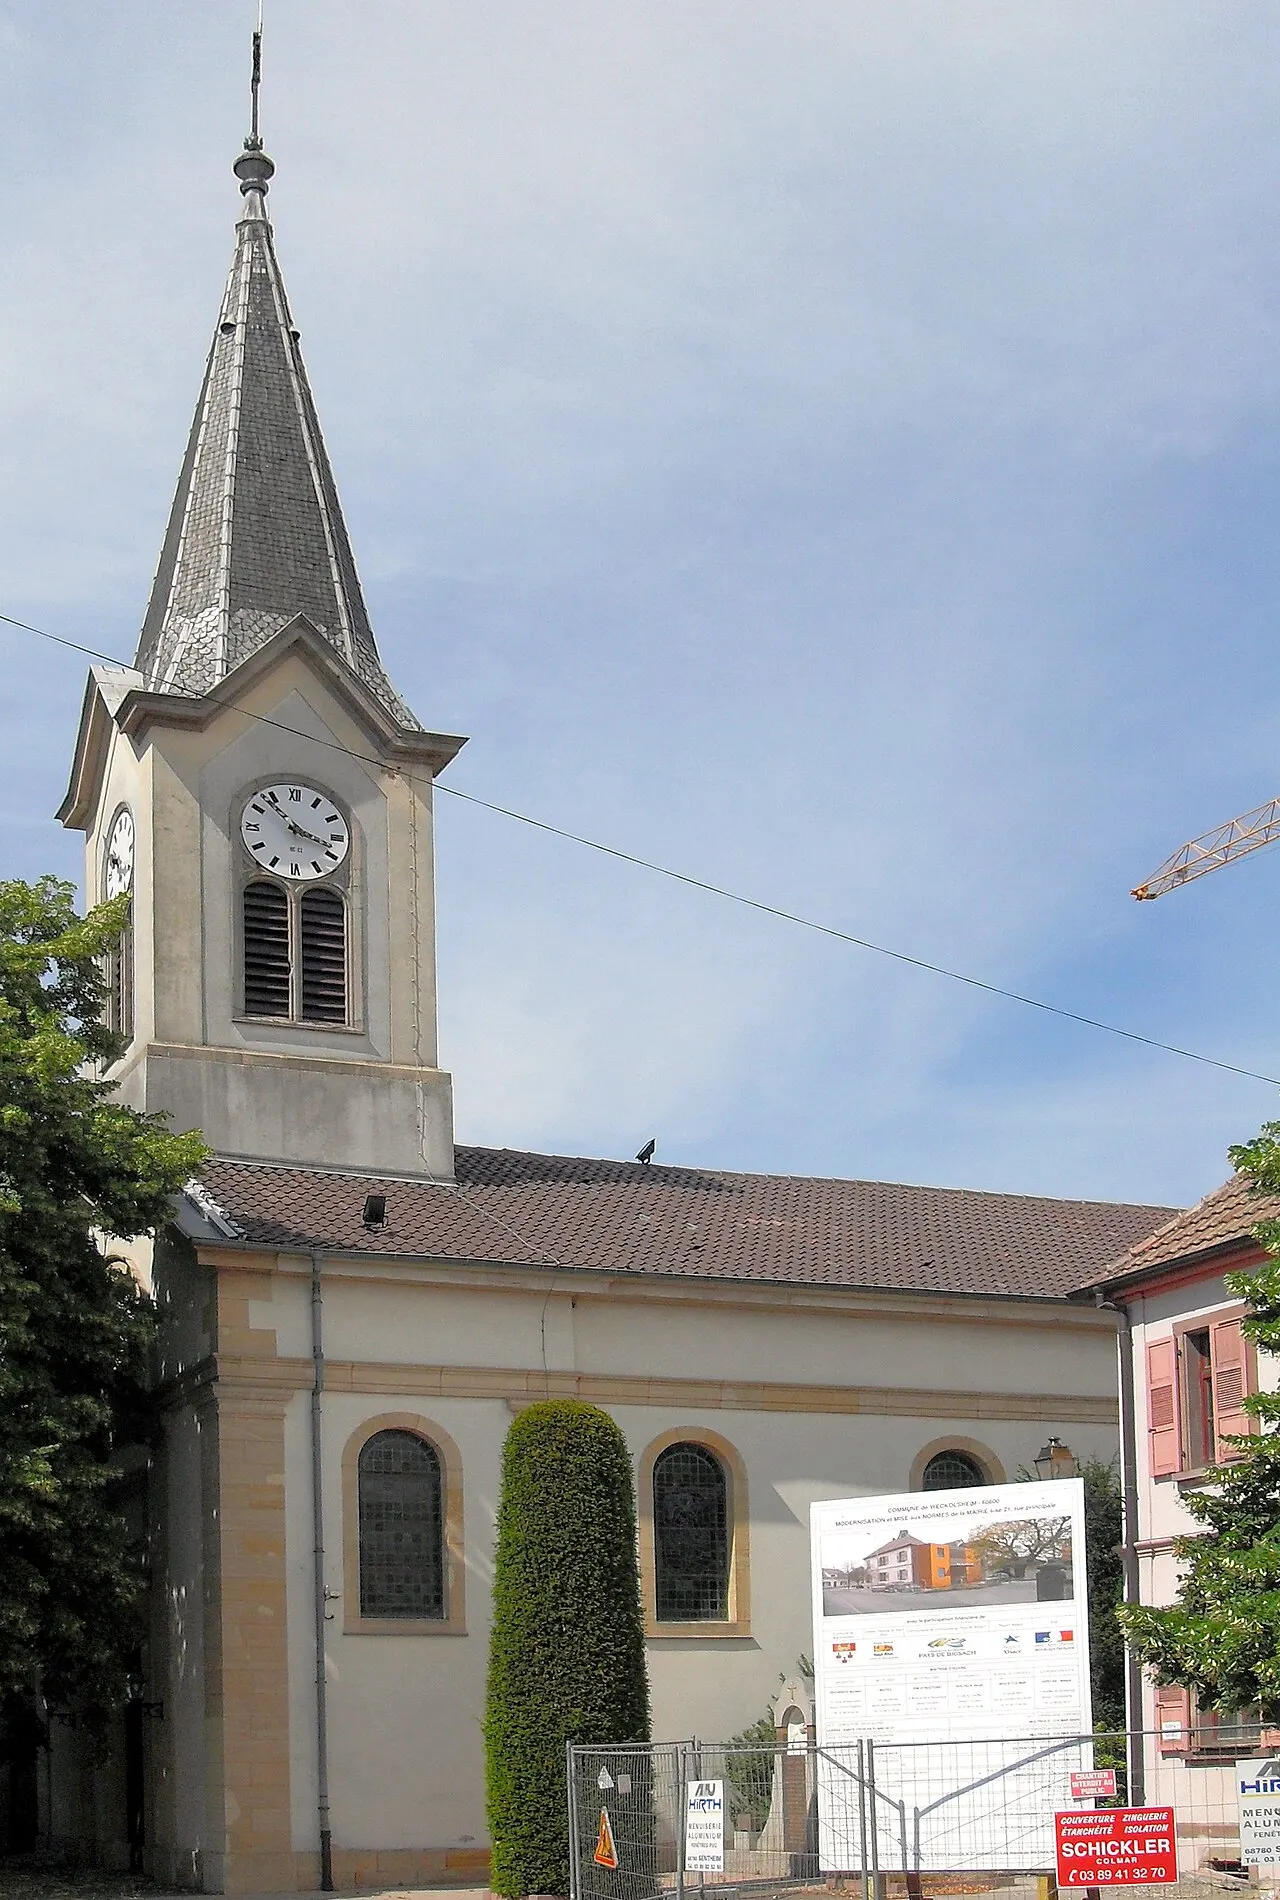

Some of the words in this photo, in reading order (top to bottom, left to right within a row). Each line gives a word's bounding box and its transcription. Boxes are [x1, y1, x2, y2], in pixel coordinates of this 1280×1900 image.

[1060, 1814, 1116, 1826] COUVERTURE
[1121, 1811, 1169, 1823] ZINGUERIE
[1124, 1823, 1169, 1835] ISOLATION
[1061, 1838, 1171, 1858] SCHICKLER
[1244, 1847, 1272, 1855] 68780
[1095, 1856, 1138, 1866] COLMAR
[1079, 1870, 1095, 1881] 03
[1097, 1869, 1113, 1880] 89
[1114, 1869, 1129, 1880] 41
[1132, 1868, 1148, 1879] 32
[1150, 1867, 1166, 1878] 70
